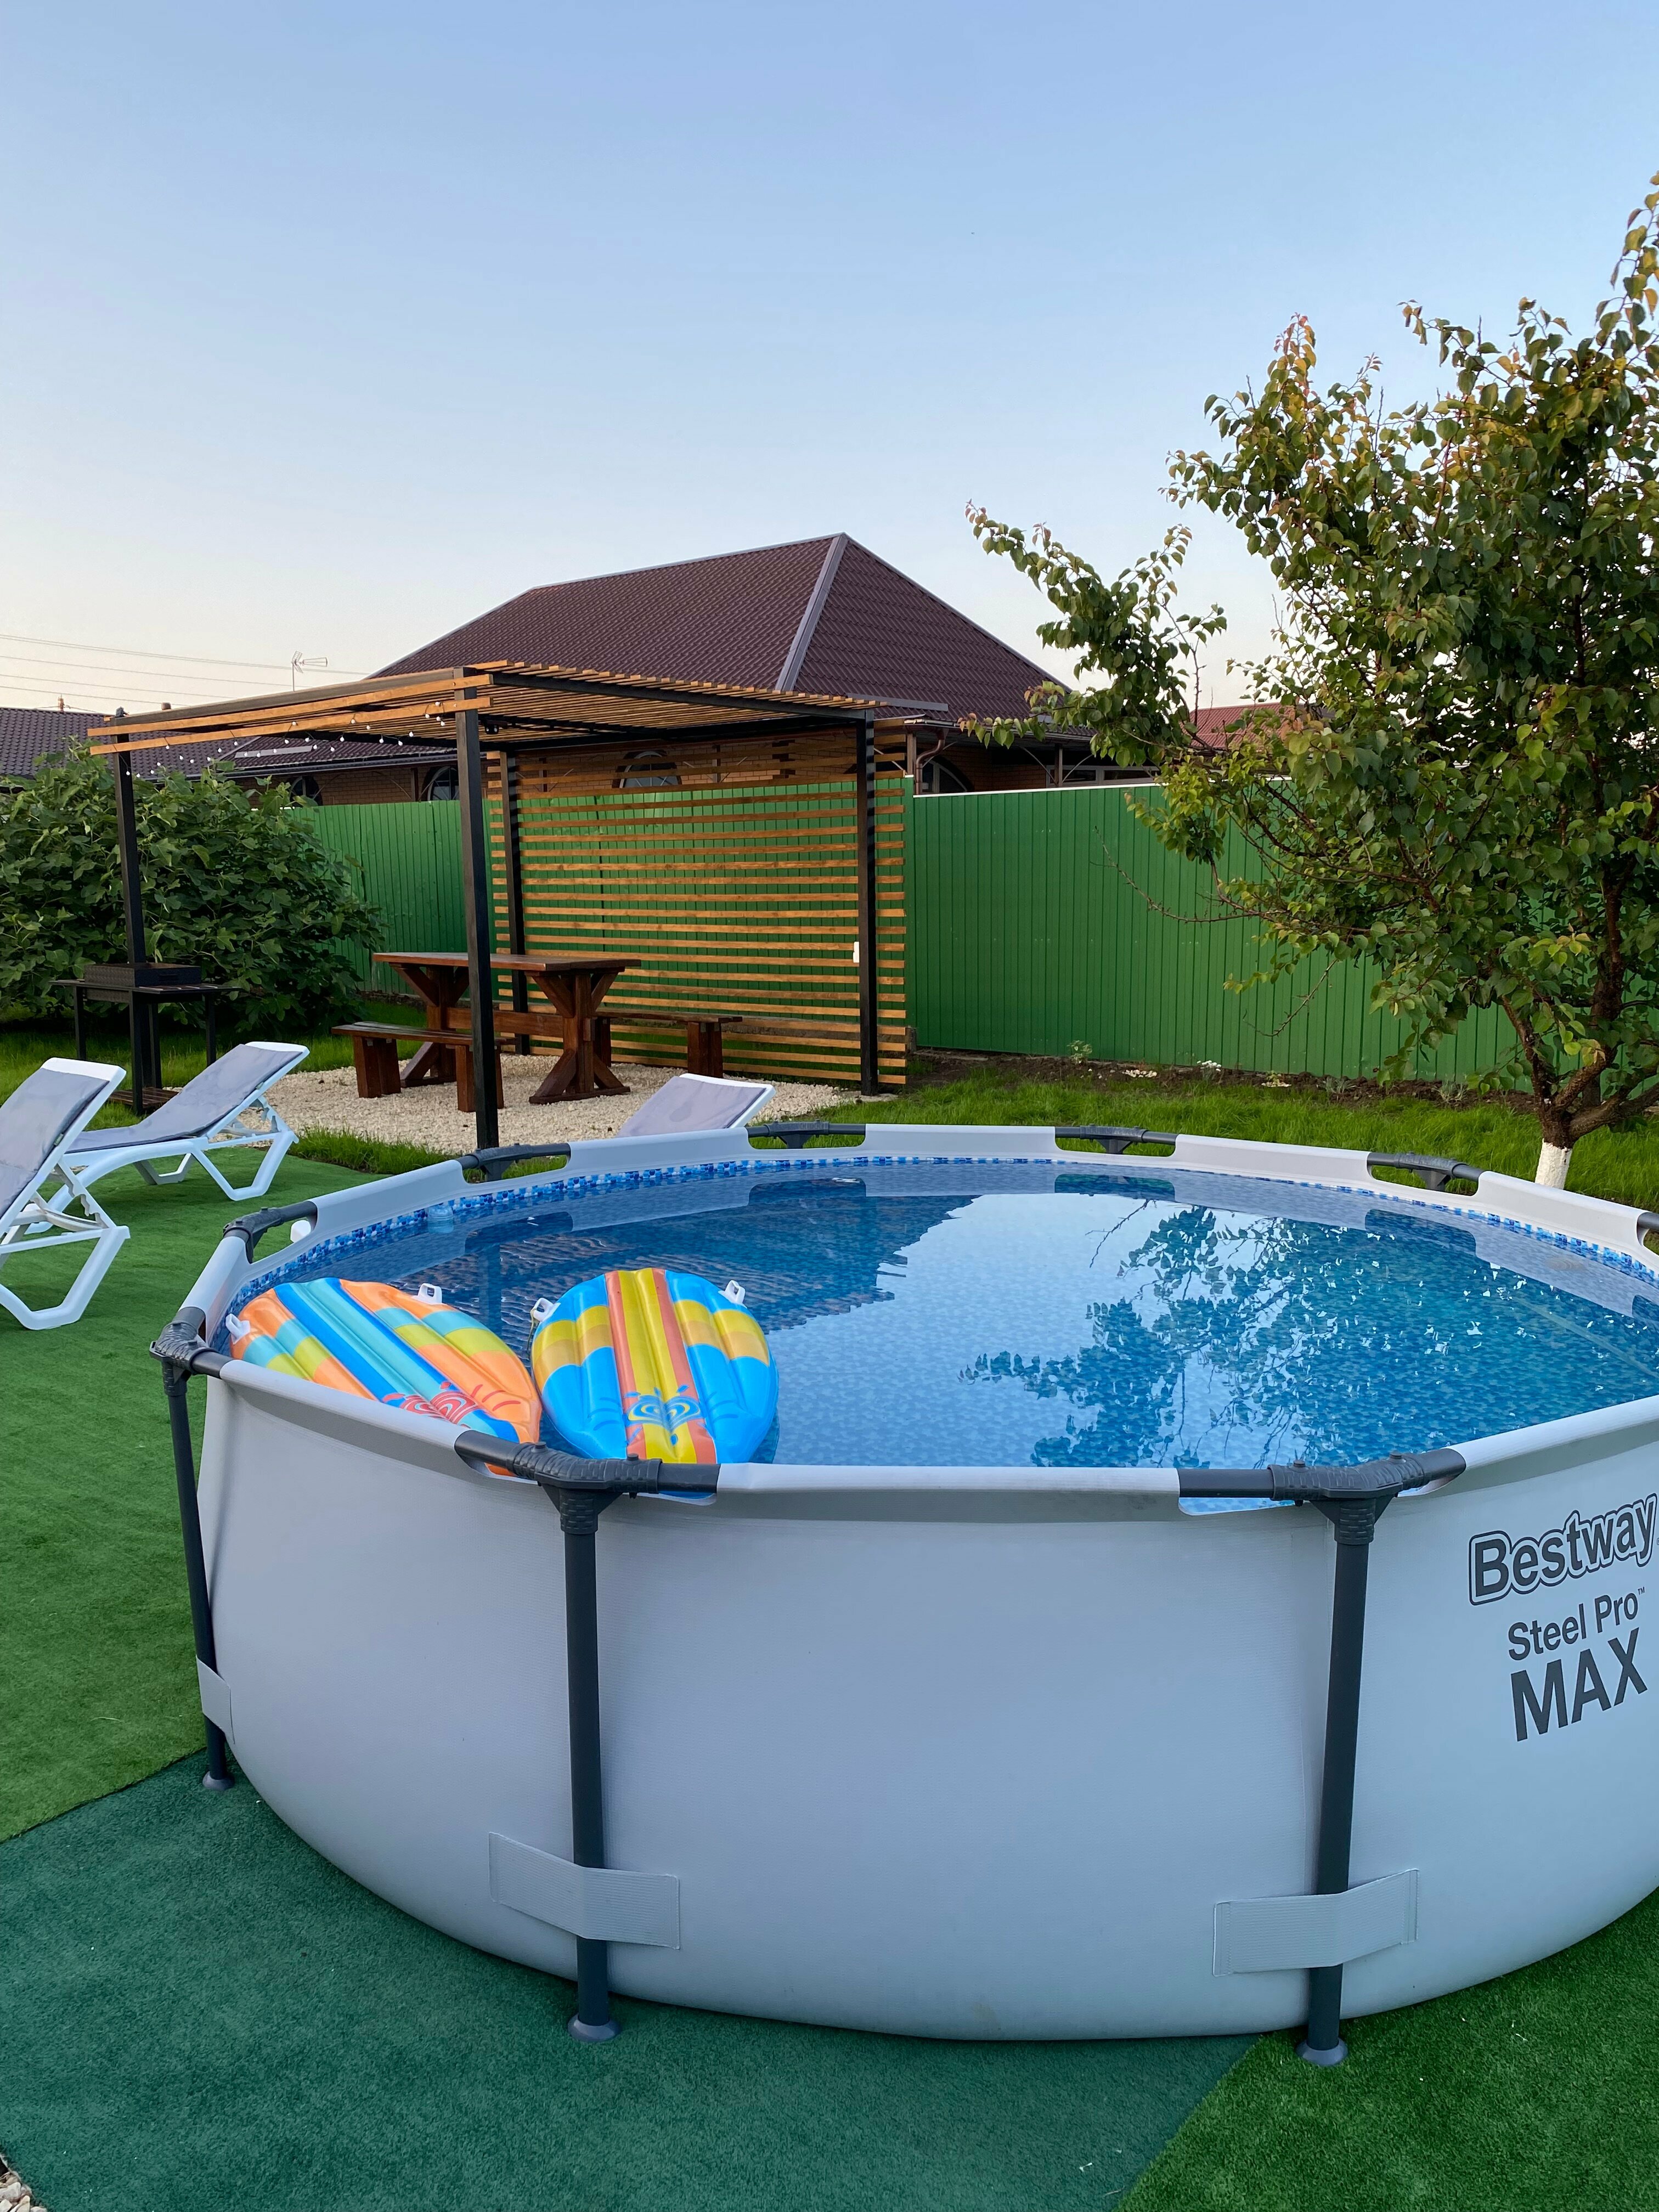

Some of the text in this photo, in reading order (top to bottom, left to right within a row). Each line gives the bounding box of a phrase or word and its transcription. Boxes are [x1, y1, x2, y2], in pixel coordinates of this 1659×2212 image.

[1469, 1492, 1656, 1605] Bestway
[1508, 1604, 1586, 1661] Steel
[1511, 1627, 1648, 1742] MAX
